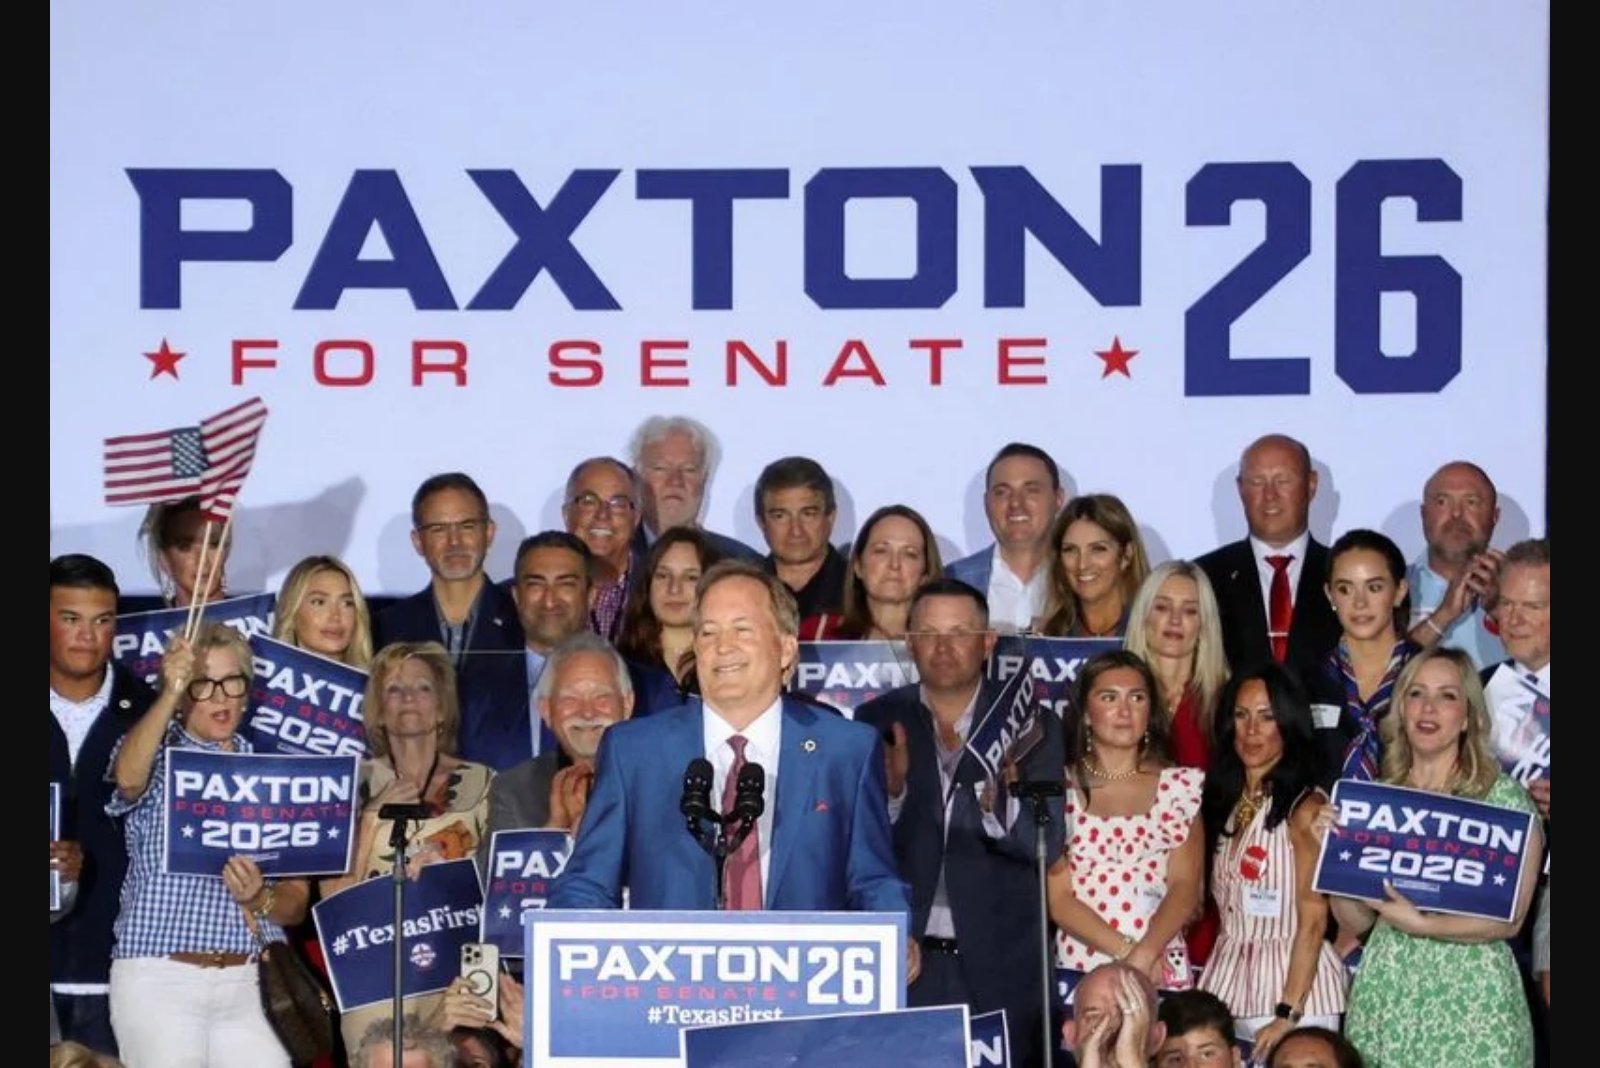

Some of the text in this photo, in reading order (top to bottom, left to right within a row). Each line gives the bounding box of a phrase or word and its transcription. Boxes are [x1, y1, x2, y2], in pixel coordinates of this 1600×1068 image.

[125, 158, 1463, 397] PAXTON 26
[232, 339, 1048, 387] FOR SENATE
[174, 770, 350, 804] PAXTON
[175, 801, 349, 820] FOR SENATE
[1339, 800, 1523, 853] PAXTON
[201, 819, 321, 850] 2026
[1358, 846, 1486, 886] 2026
[1405, 837, 1517, 868] SENATE
[558, 945, 875, 1005] PAXTON 26
[580, 985, 778, 1000] FOR SENATE
[648, 1004, 783, 1025] #TexasFirst
